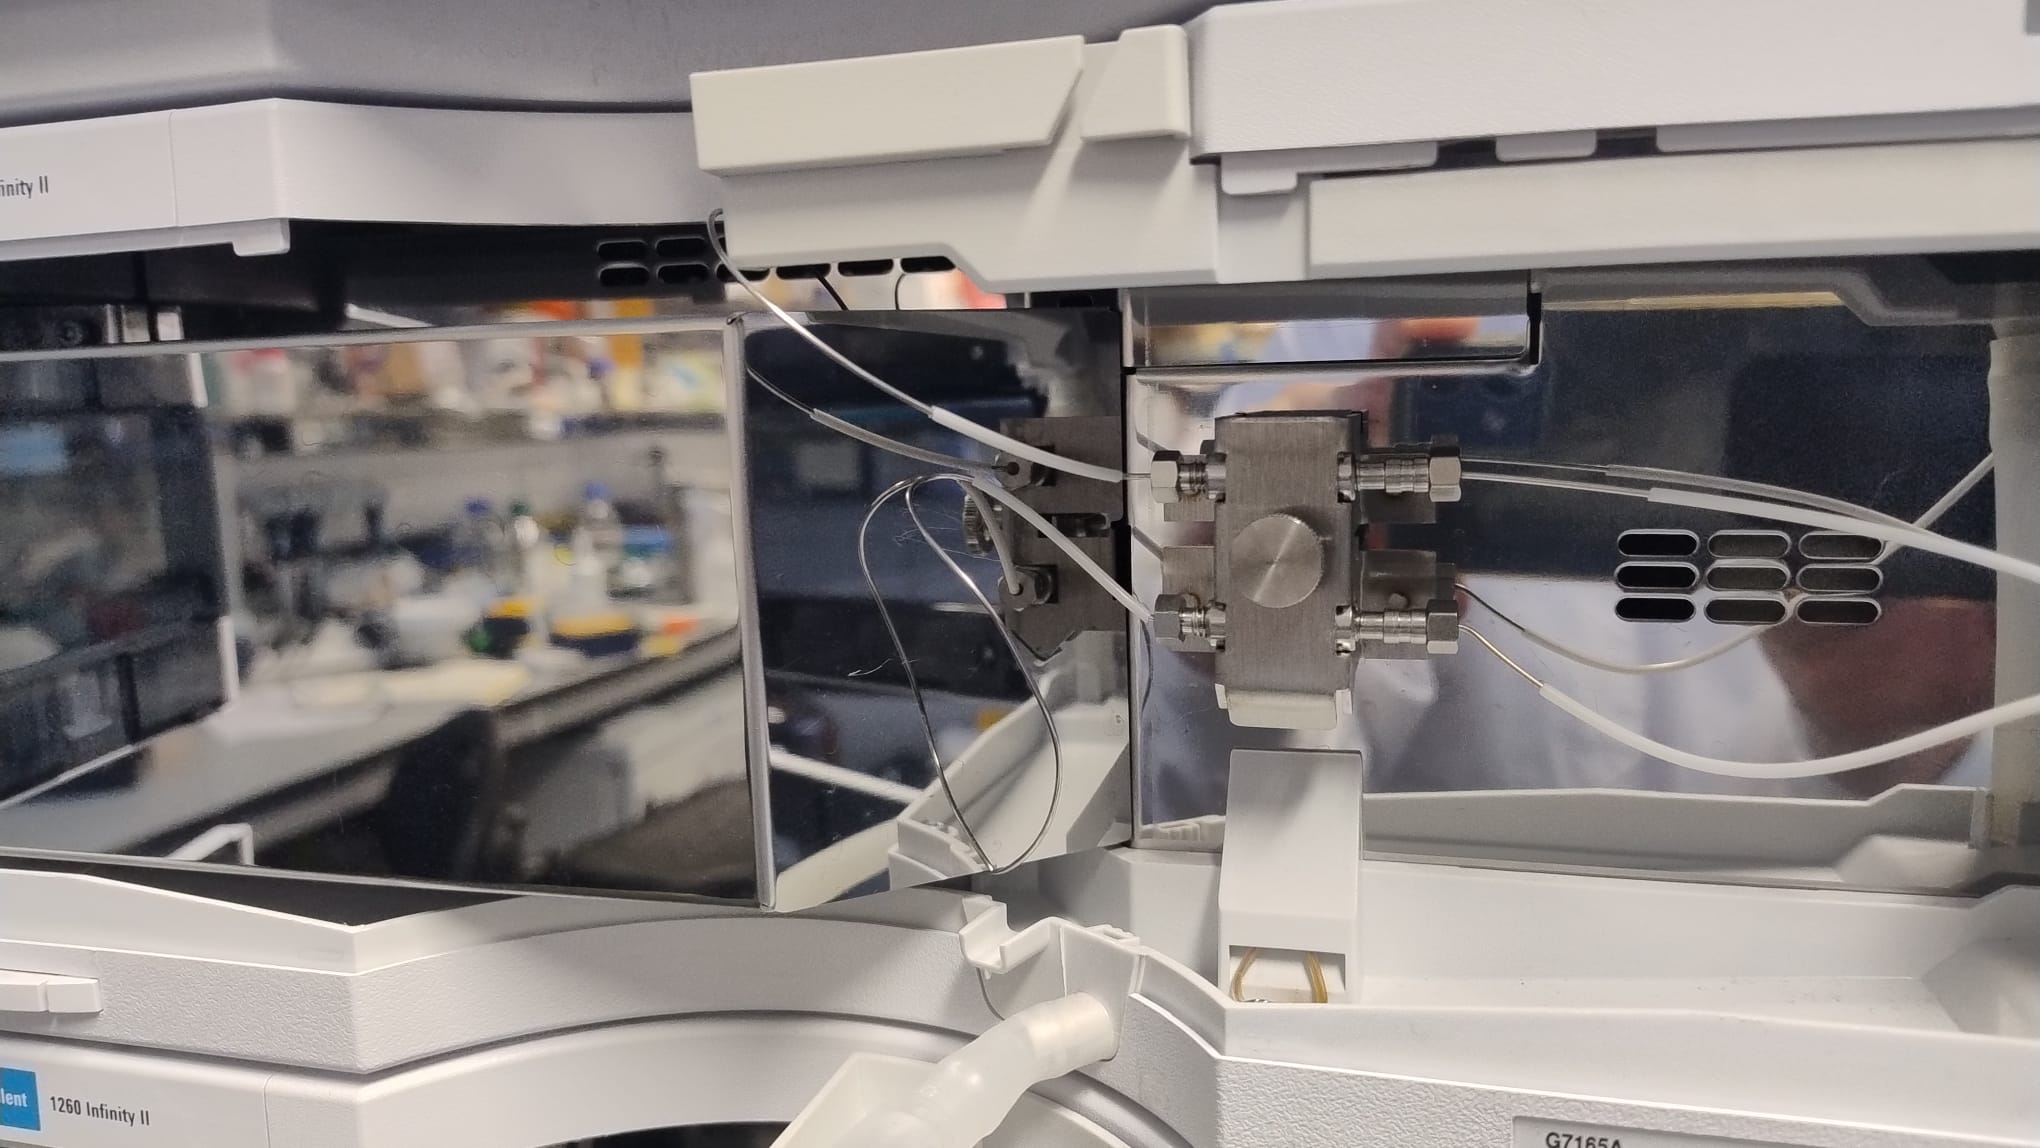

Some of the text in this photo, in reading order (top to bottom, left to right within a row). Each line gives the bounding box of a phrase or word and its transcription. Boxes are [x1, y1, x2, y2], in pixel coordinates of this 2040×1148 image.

[0, 178, 33, 199] inity
[50, 1096, 150, 1127] 1260 Infinity II
